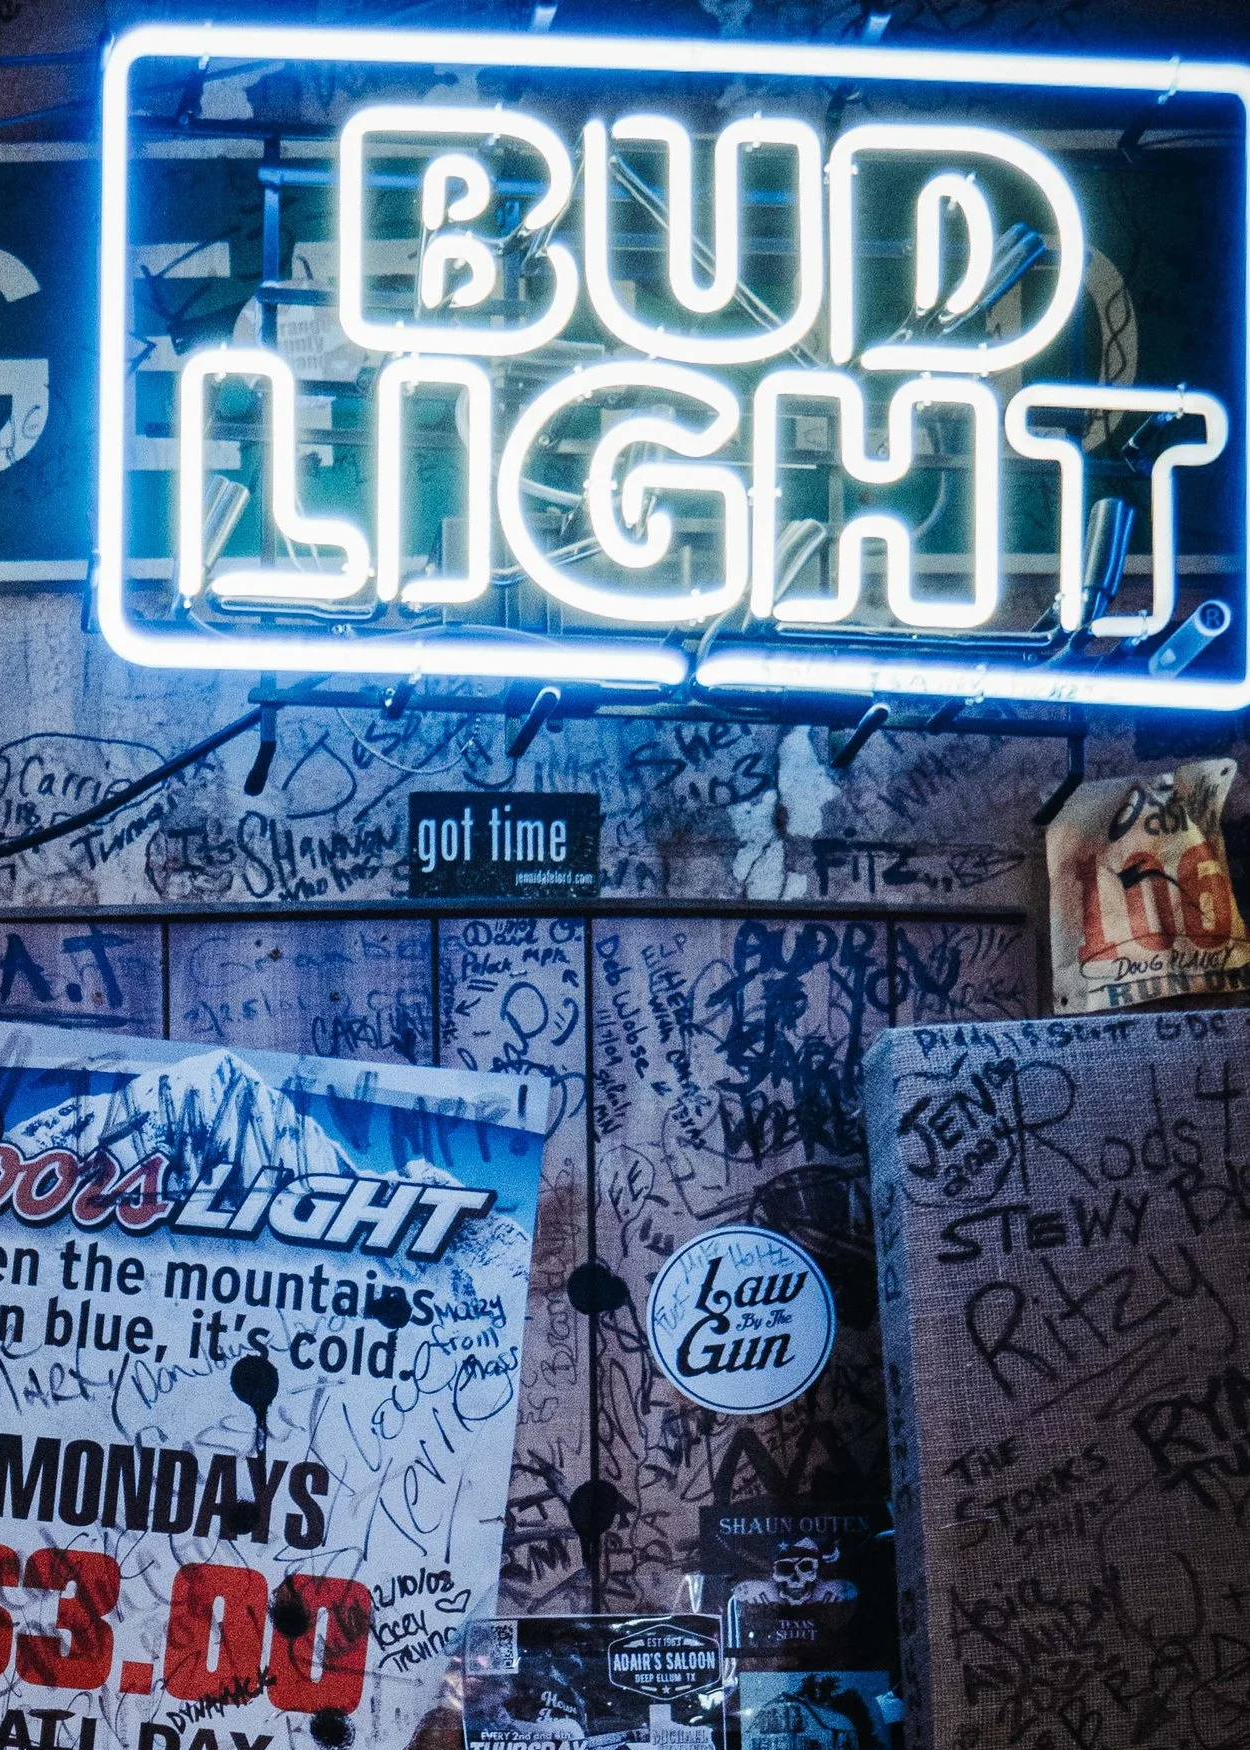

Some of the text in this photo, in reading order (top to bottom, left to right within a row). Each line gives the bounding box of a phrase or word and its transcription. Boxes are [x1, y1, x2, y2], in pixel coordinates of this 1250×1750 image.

[338, 105, 1085, 374] BUD
[179, 345, 1228, 638] LIGHT
[418, 807, 474, 873] got
[488, 804, 567, 863] time
[170, 1161, 498, 1264] LIGHT
[59, 1239, 144, 1297] the
[163, 1260, 436, 1328] mountains
[695, 1255, 810, 1312] Law
[44, 1297, 167, 1364] blue,
[189, 1307, 270, 1361] it's
[289, 1326, 414, 1381] cold.
[676, 1310, 797, 1379] Gun
[736, 1310, 795, 1332] By The
[718, 1516, 792, 1537] SHAUN
[778, 1618, 816, 1632] TEXAS
[612, 1650, 717, 1673] ADAIR'S SALOON
[634, 1672, 697, 1684] DEEP ELLUM TX
